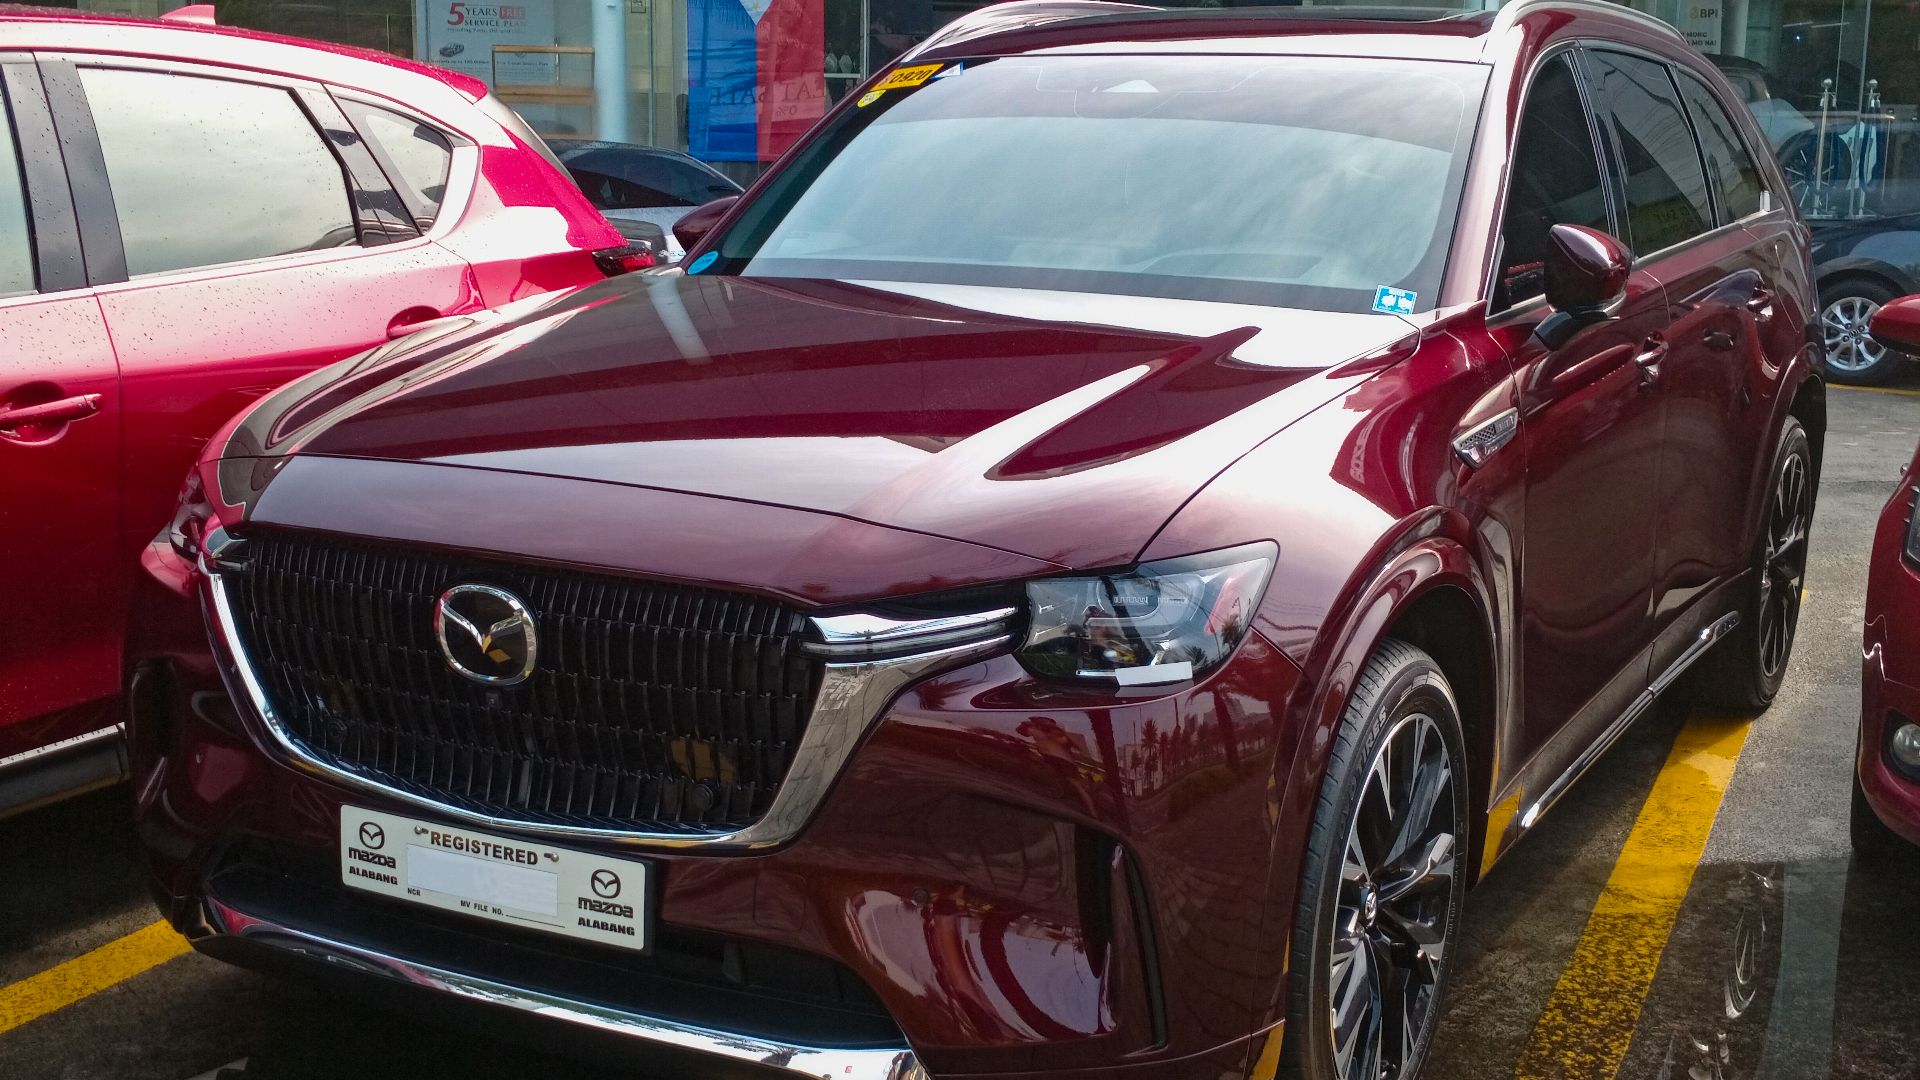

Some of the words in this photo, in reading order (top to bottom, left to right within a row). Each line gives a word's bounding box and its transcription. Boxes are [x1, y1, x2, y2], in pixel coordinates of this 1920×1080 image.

[447, 2, 465, 26] 5
[465, 7, 497, 17] YEARS
[464, 19, 500, 27] SERVICE
[1700, 8, 1718, 18] BPI
[348, 846, 396, 869] mazda
[430, 830, 538, 865] REGISTERED
[348, 866, 398, 886] ALABANG
[407, 887, 421, 897] NCR
[460, 899, 471, 909] MV
[473, 902, 489, 913] FILE
[492, 906, 504, 917] NO.
[577, 896, 634, 919] mazda
[577, 916, 636, 937] ALABANG
